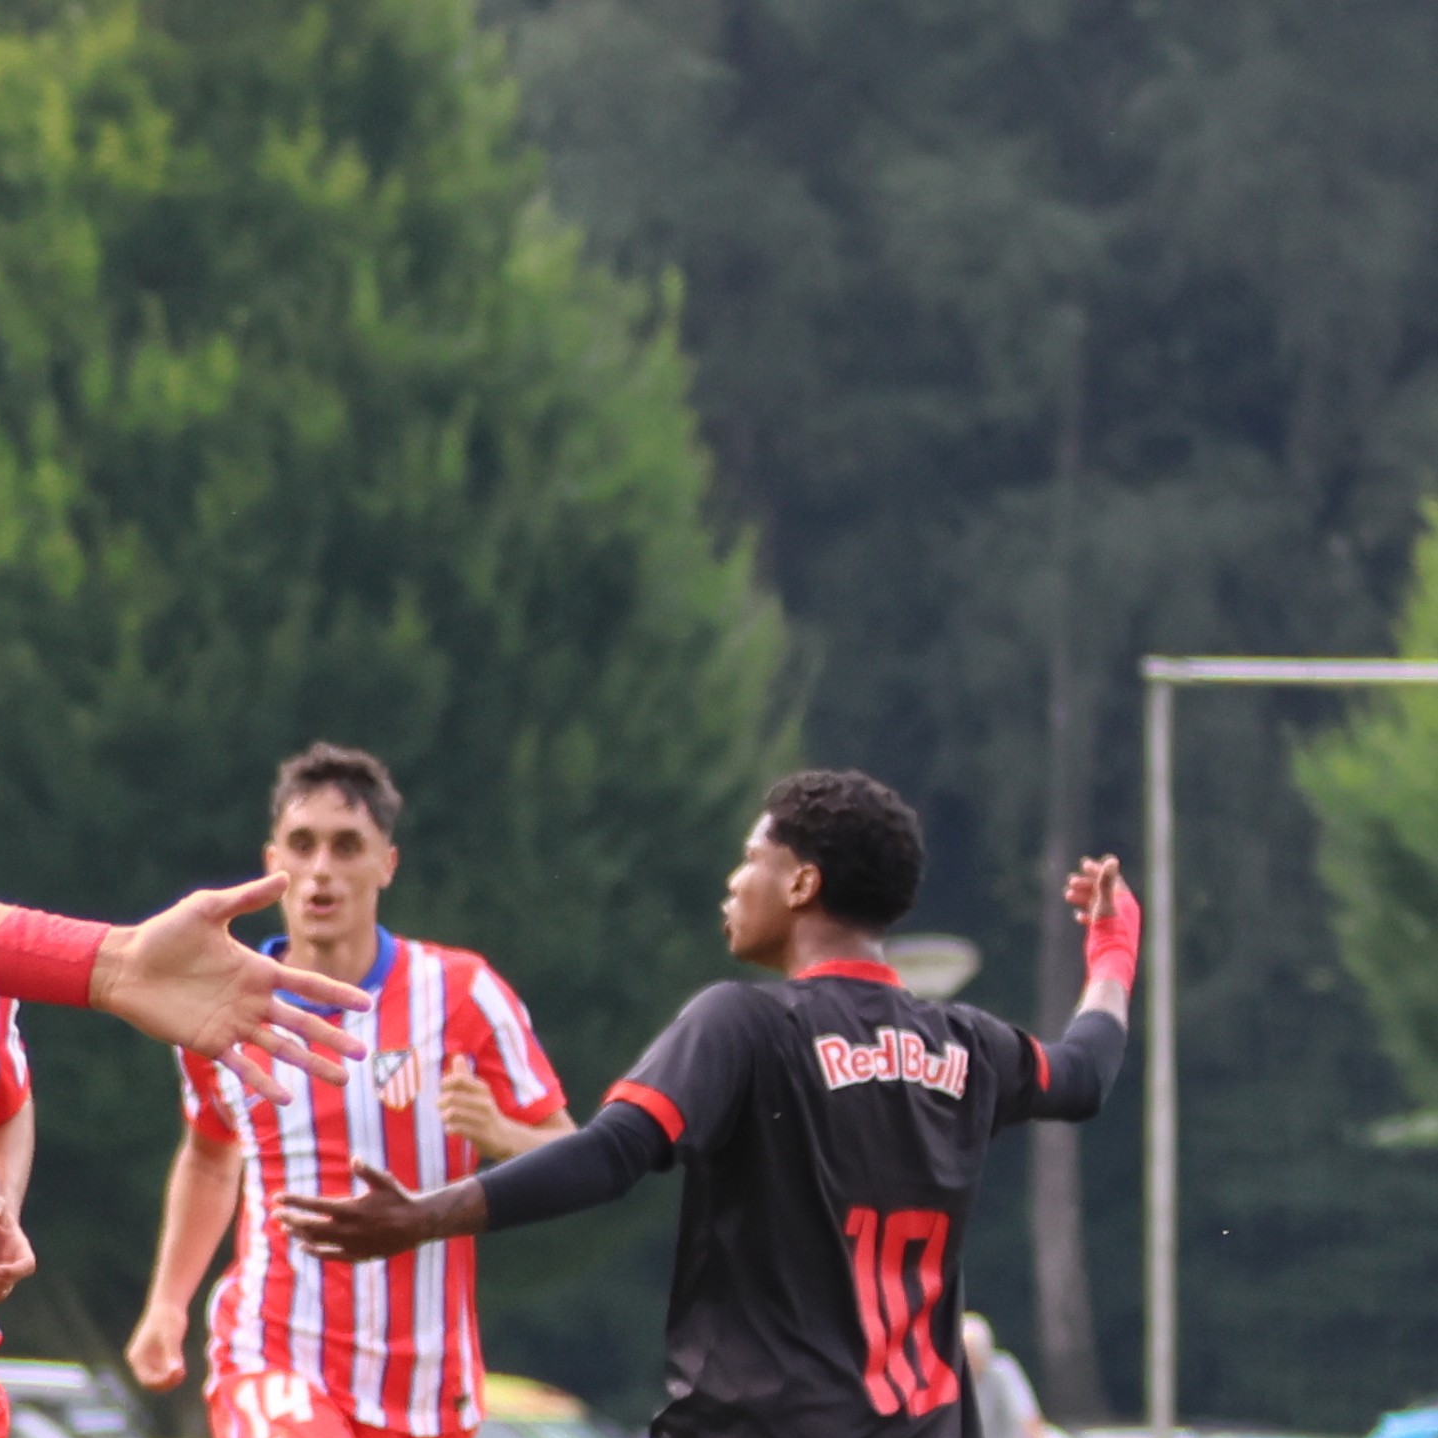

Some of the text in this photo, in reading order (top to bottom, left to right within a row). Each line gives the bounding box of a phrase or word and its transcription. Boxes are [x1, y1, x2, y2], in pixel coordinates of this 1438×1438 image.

[815, 1026, 969, 1100] Red Bull
[845, 1208, 960, 1417] 10
